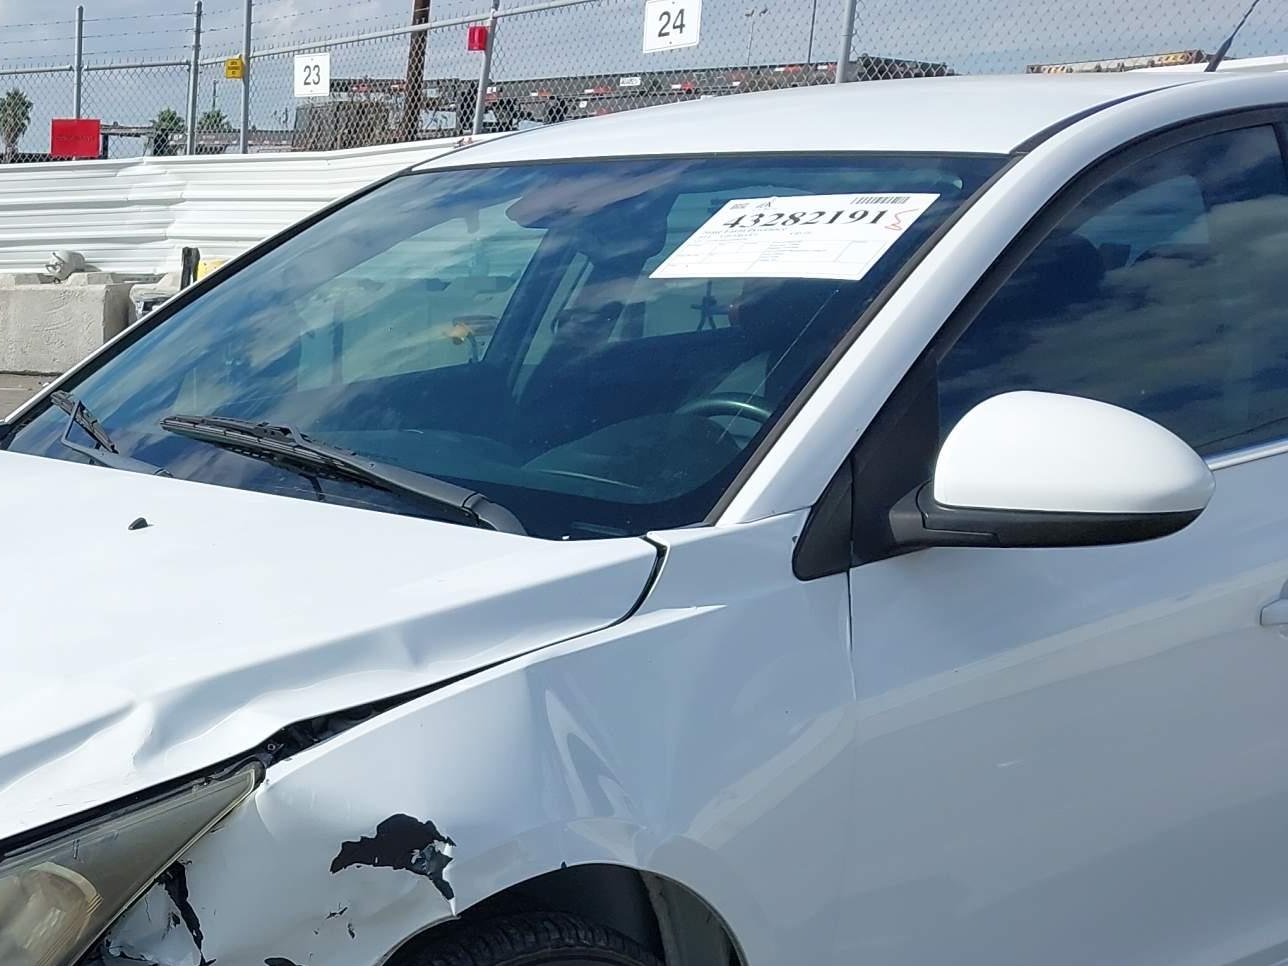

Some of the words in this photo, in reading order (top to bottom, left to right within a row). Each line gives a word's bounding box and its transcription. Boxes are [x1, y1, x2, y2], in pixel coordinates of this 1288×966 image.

[658, 8, 685, 37] 24
[304, 65, 321, 85] 23
[722, 209, 888, 230] 43282191
